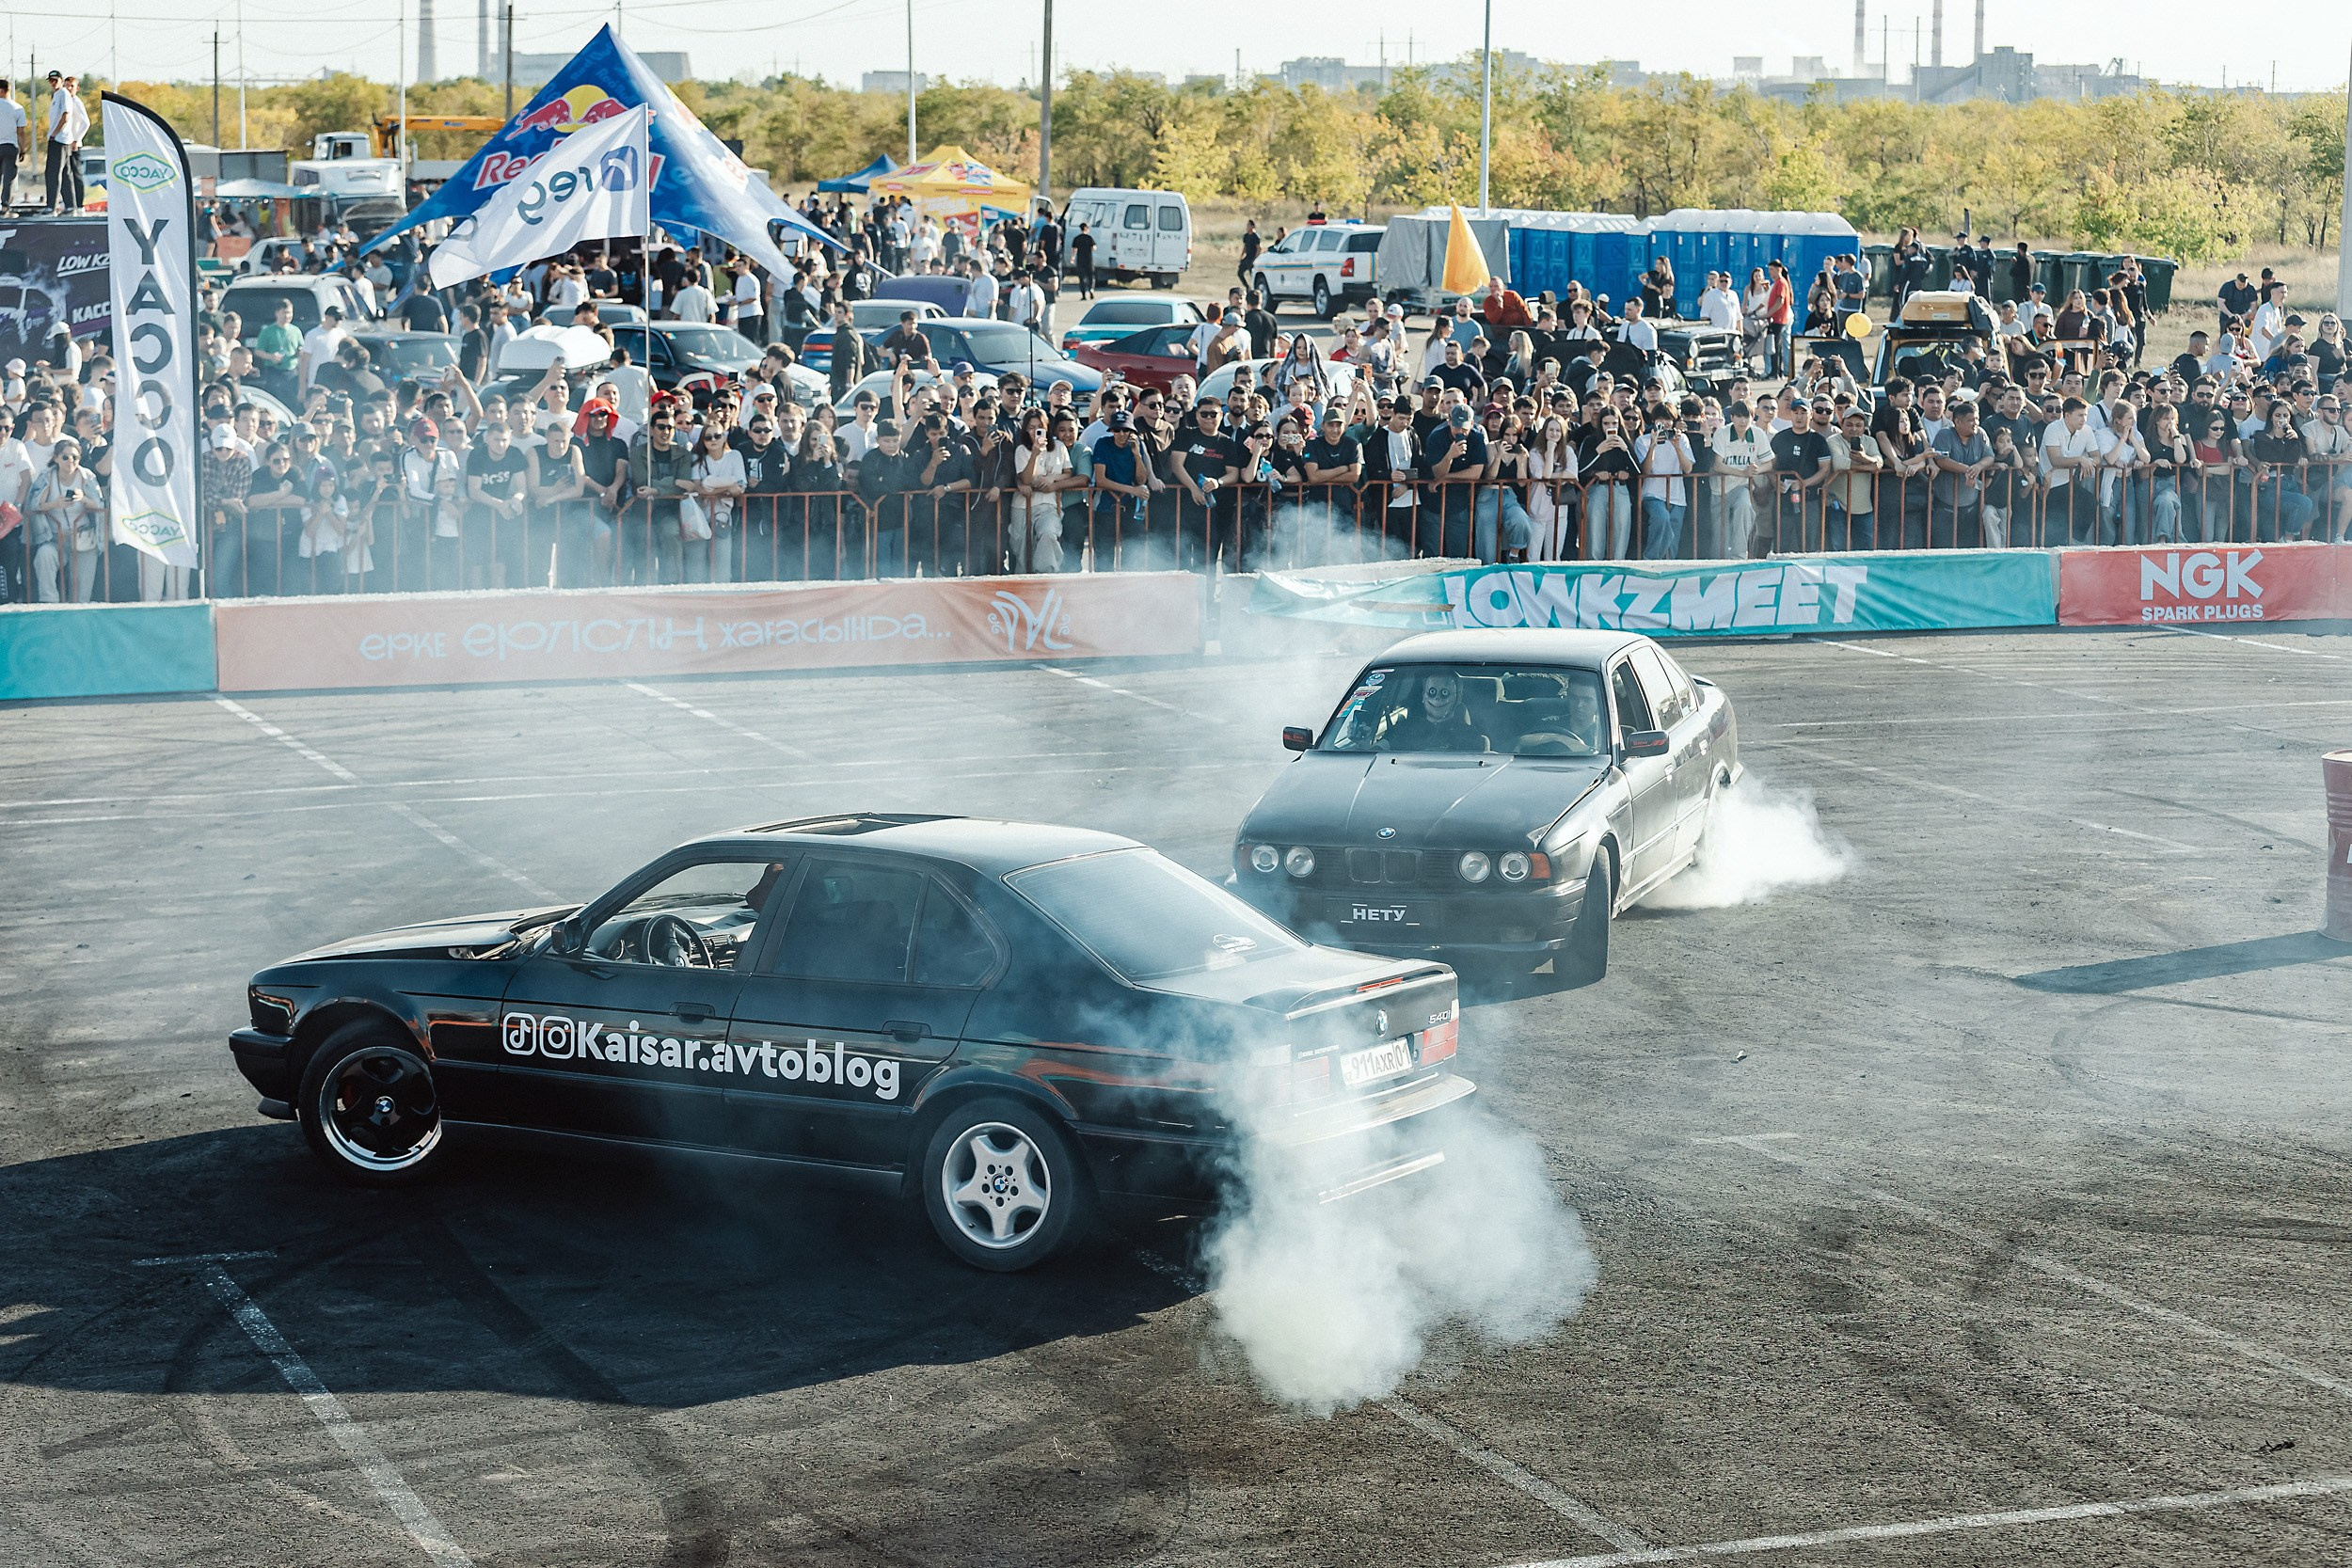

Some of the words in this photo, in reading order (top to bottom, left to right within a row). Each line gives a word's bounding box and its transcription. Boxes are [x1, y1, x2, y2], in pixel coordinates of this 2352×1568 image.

[56, 254, 91, 272] LOW
[2140, 548, 2265, 601] NGK
[2141, 605, 2200, 622] SPARK
[2204, 604, 2264, 619] PLUGS
[1353, 908, 1406, 921] НЕТУ
[1428, 1009, 1452, 1023] 540i
[578, 1020, 900, 1101] Kaisar.avtoblog
